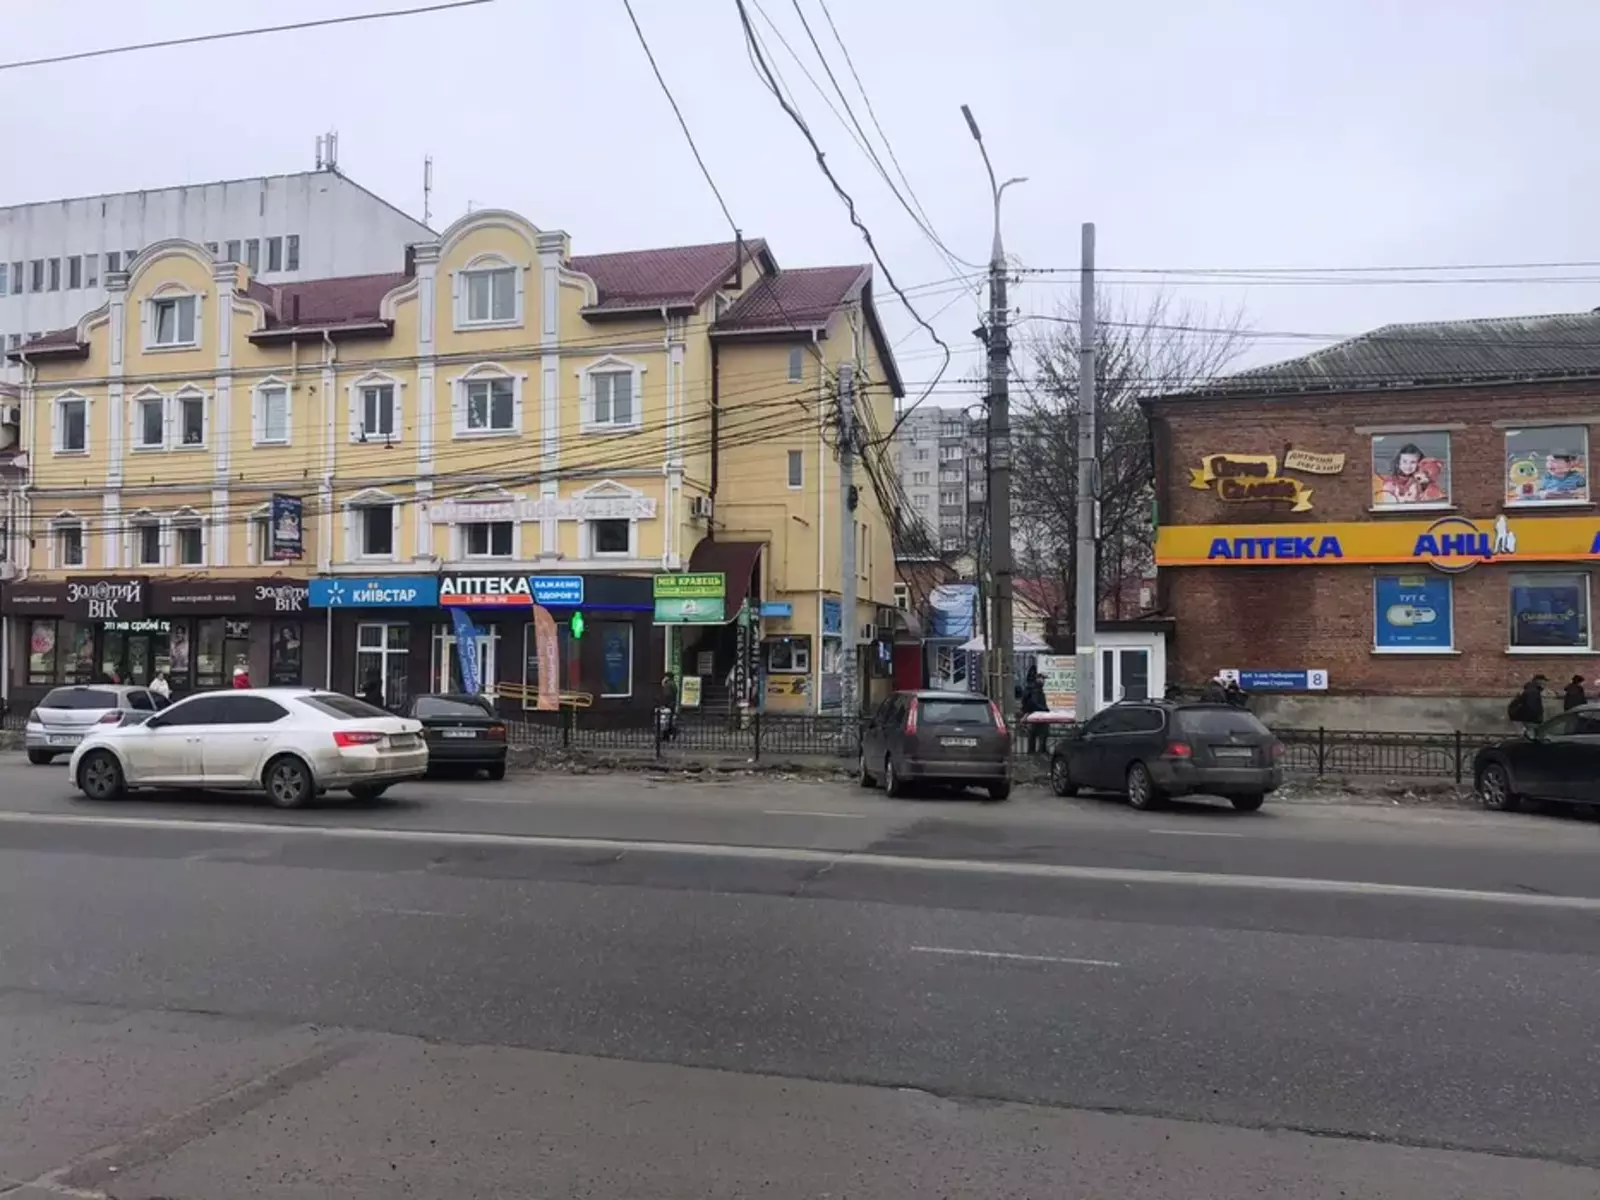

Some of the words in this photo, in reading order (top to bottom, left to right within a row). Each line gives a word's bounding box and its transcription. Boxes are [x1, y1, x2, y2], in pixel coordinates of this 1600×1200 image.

[1207, 536, 1343, 559] АПТЕКА
[1413, 533, 1493, 559] АНЦ
[255, 585, 309, 600] ЗОЛОТИ
[352, 583, 416, 602] КИЇВСТАР
[440, 577, 531, 594] АПТЕКА
[88, 599, 118, 618] ВІК
[275, 598, 303, 611] ВІК
[1313, 673, 1323, 686] 8
